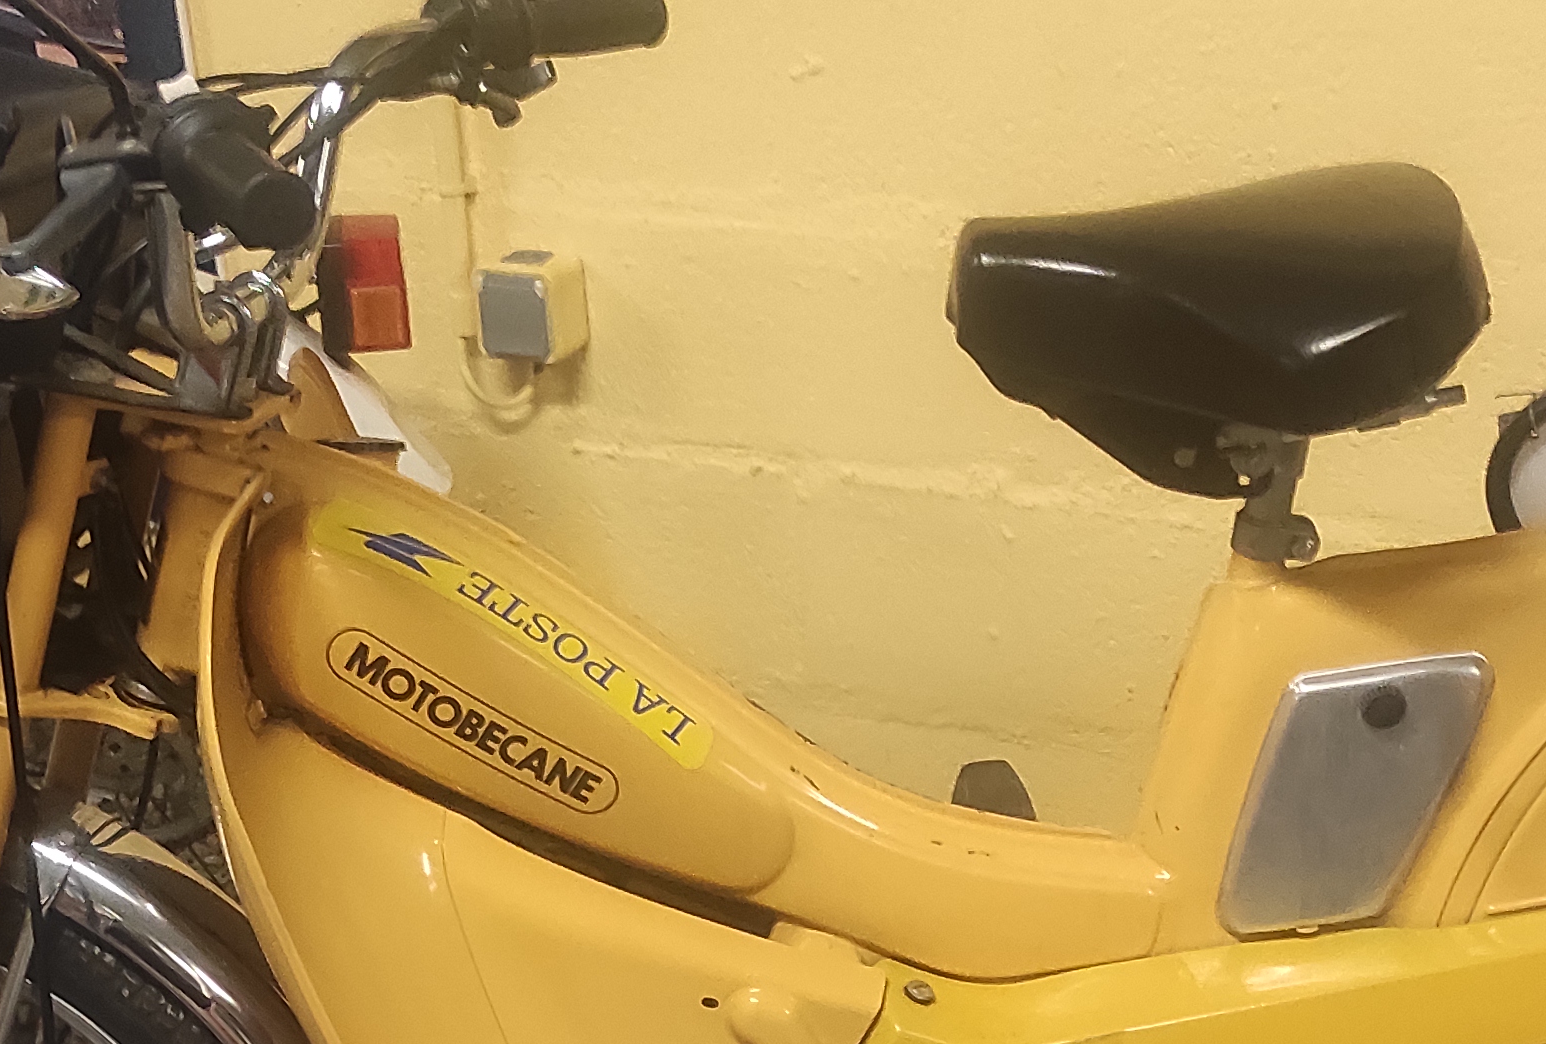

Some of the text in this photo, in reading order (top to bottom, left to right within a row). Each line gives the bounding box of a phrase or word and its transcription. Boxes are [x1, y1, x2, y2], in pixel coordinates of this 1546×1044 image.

[344, 641, 604, 805] MOTOBECANE
[456, 571, 697, 747] LA POSTE
